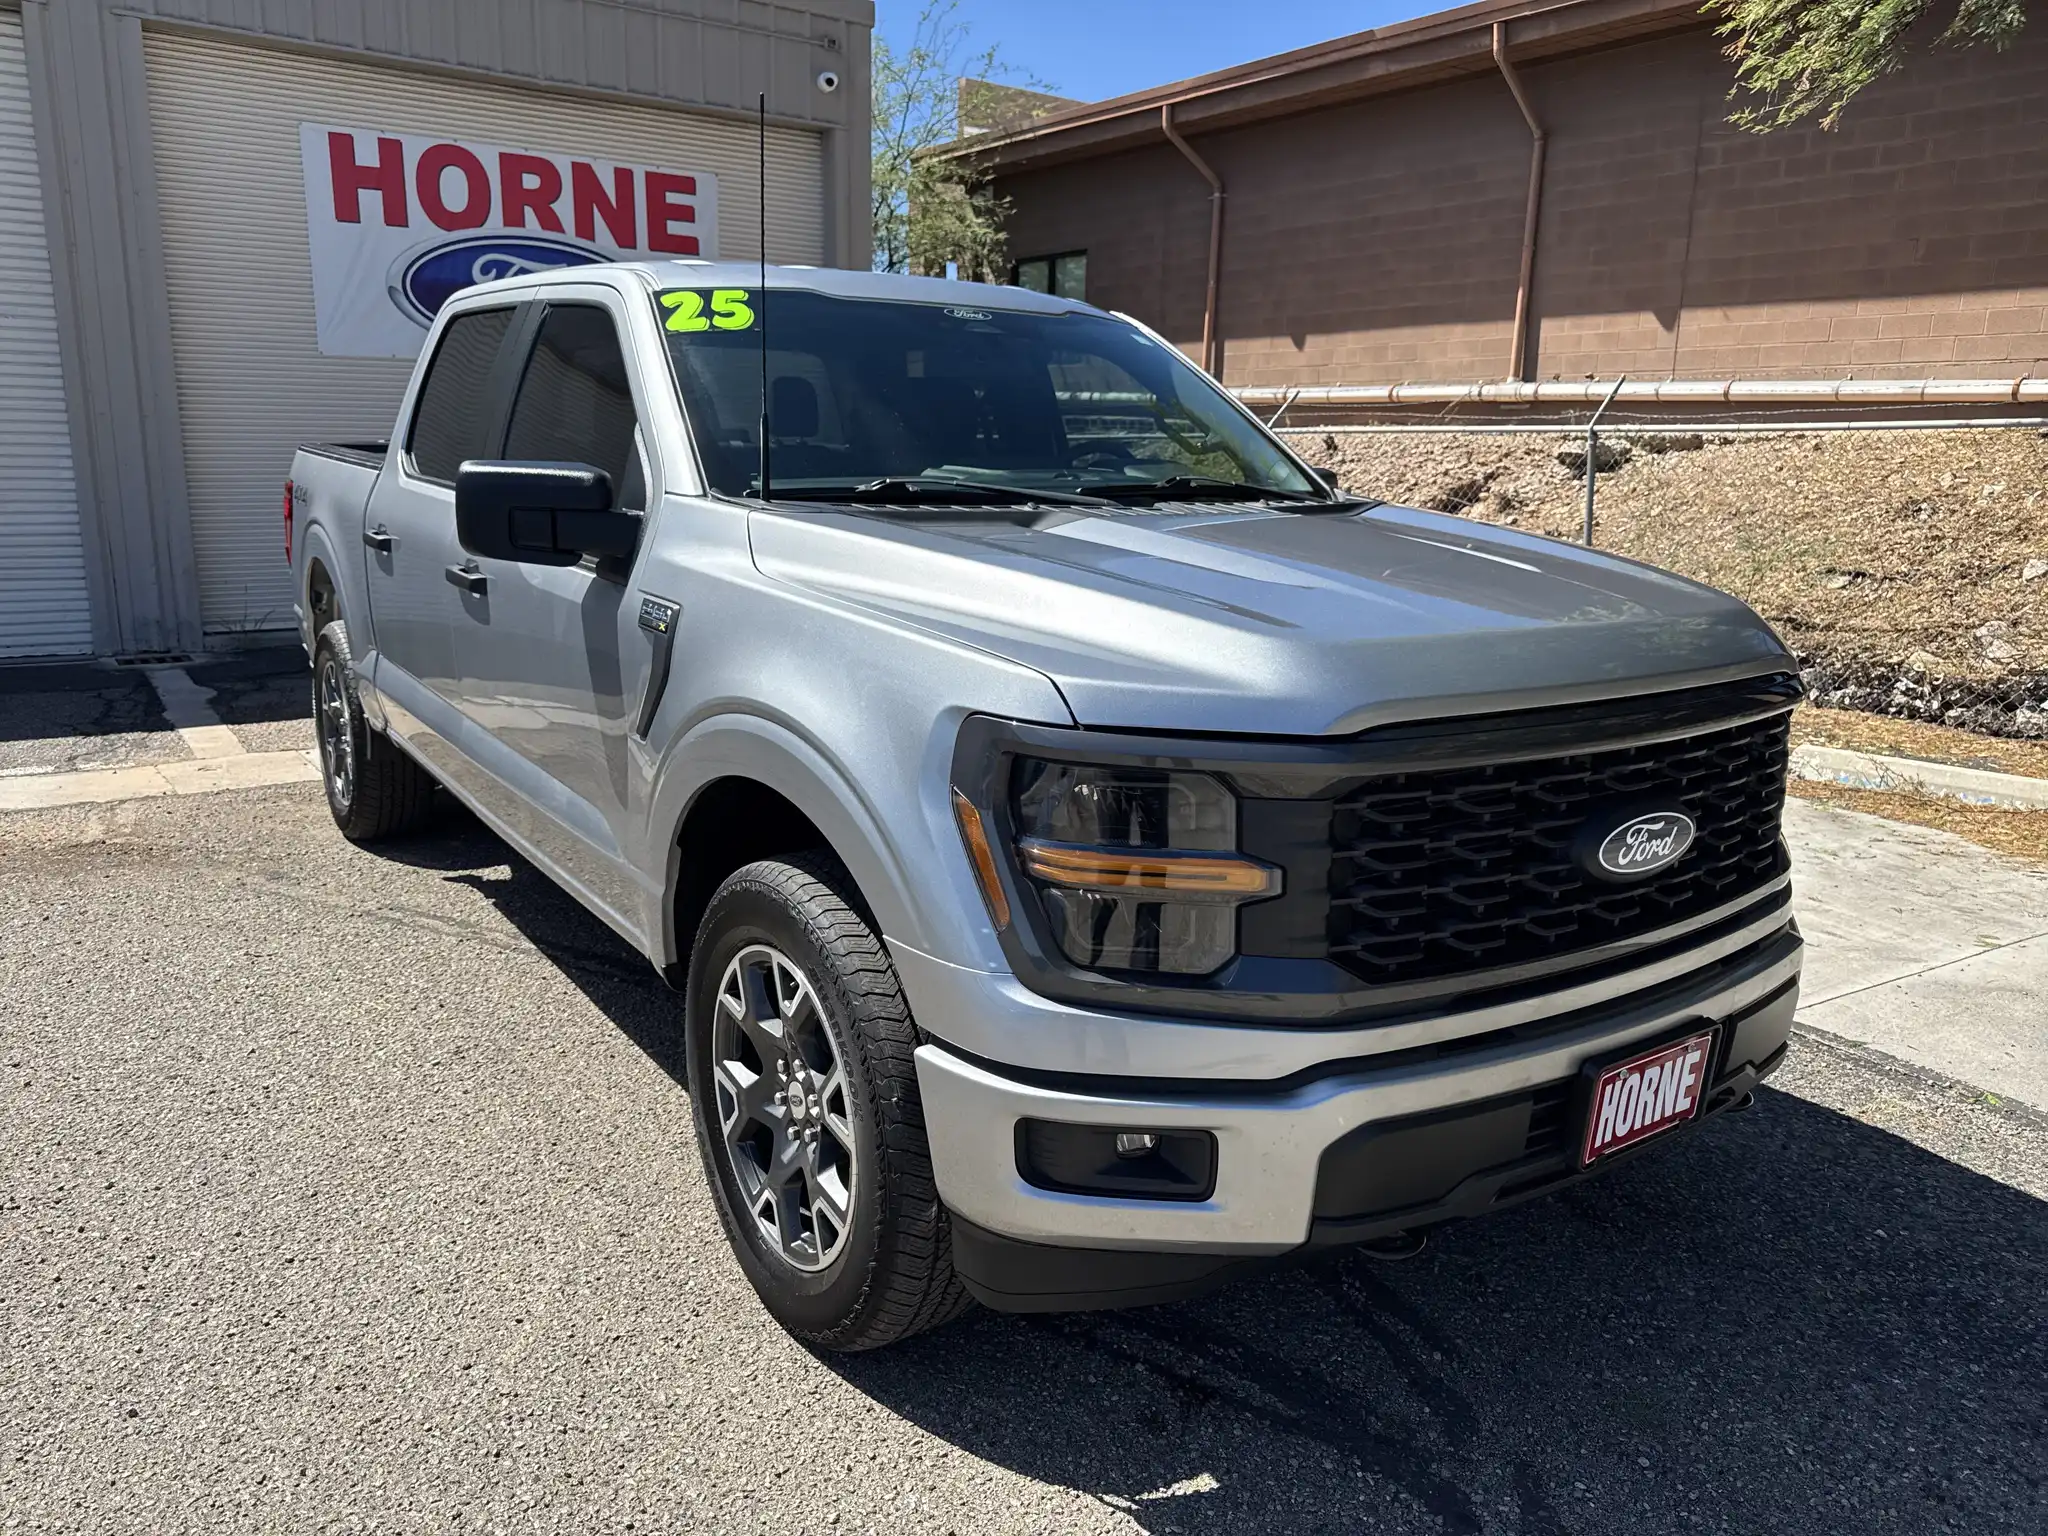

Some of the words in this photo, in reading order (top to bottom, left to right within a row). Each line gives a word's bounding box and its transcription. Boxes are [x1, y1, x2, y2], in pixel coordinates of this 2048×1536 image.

[327, 131, 700, 256] HORNE
[660, 290, 755, 332] 25
[1618, 821, 1678, 866] Ford
[1594, 1050, 1702, 1149] HORNE
